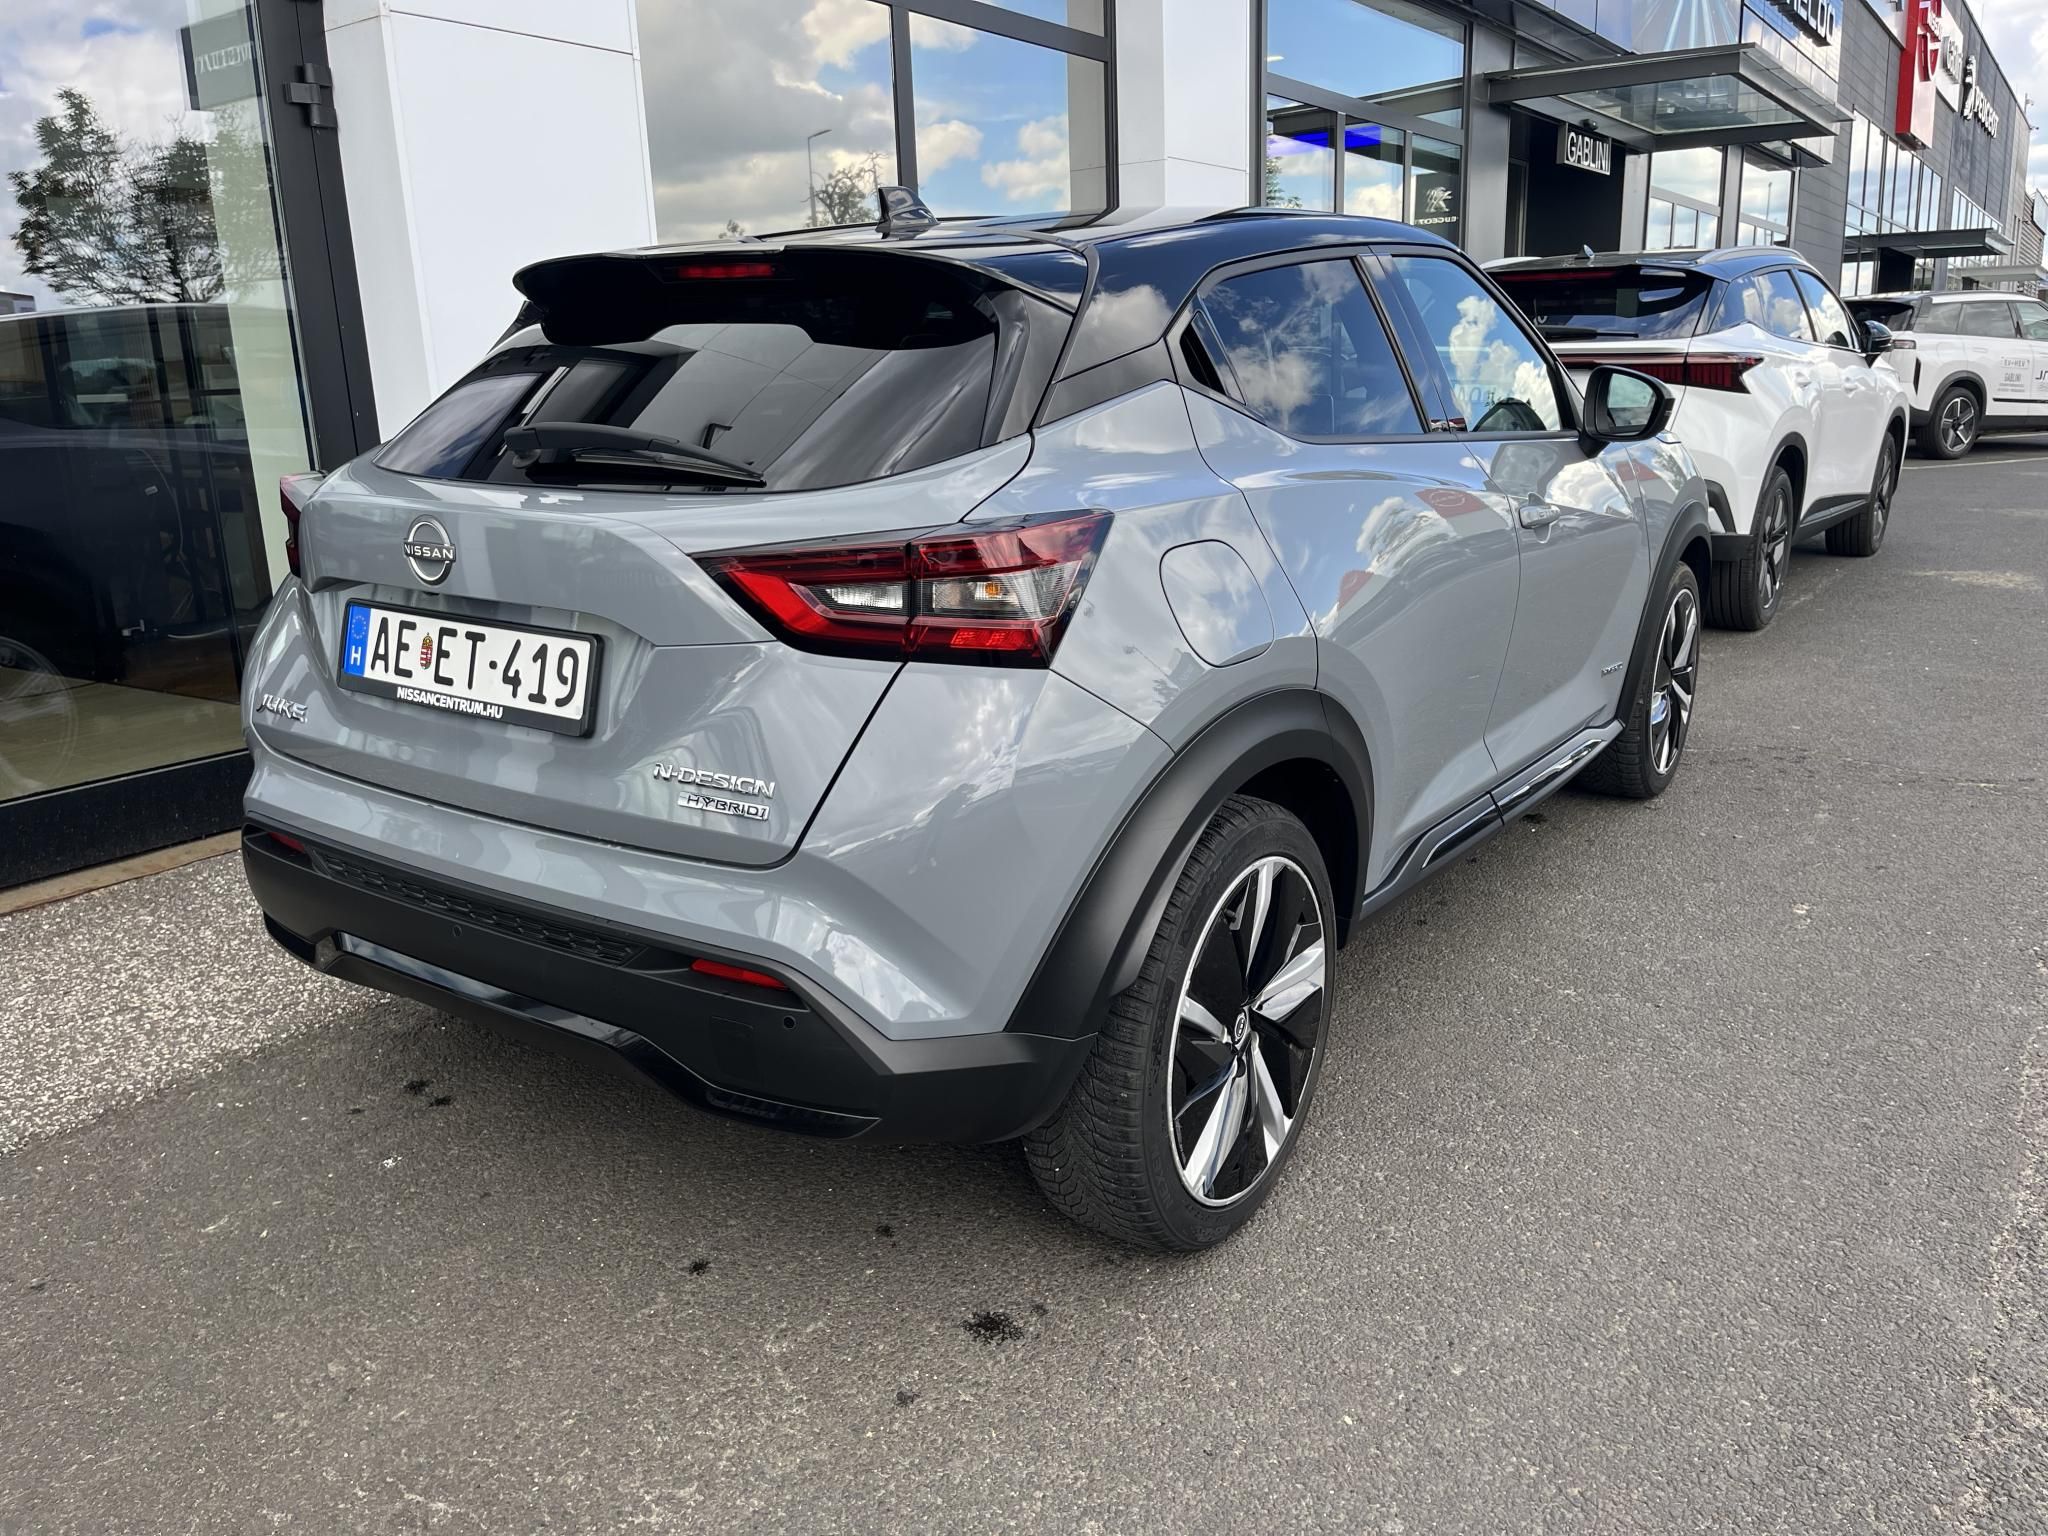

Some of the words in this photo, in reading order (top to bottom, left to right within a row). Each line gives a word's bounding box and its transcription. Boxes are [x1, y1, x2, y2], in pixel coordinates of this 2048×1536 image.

[1567, 131, 1609, 173] GABLINI
[404, 543, 454, 559] NISSAN
[350, 645, 362, 666] H
[370, 616, 417, 679] AE
[257, 694, 308, 722] JUKE
[396, 687, 504, 719] NISSANCENTRUM.HU
[653, 763, 776, 799] N-DESIGN
